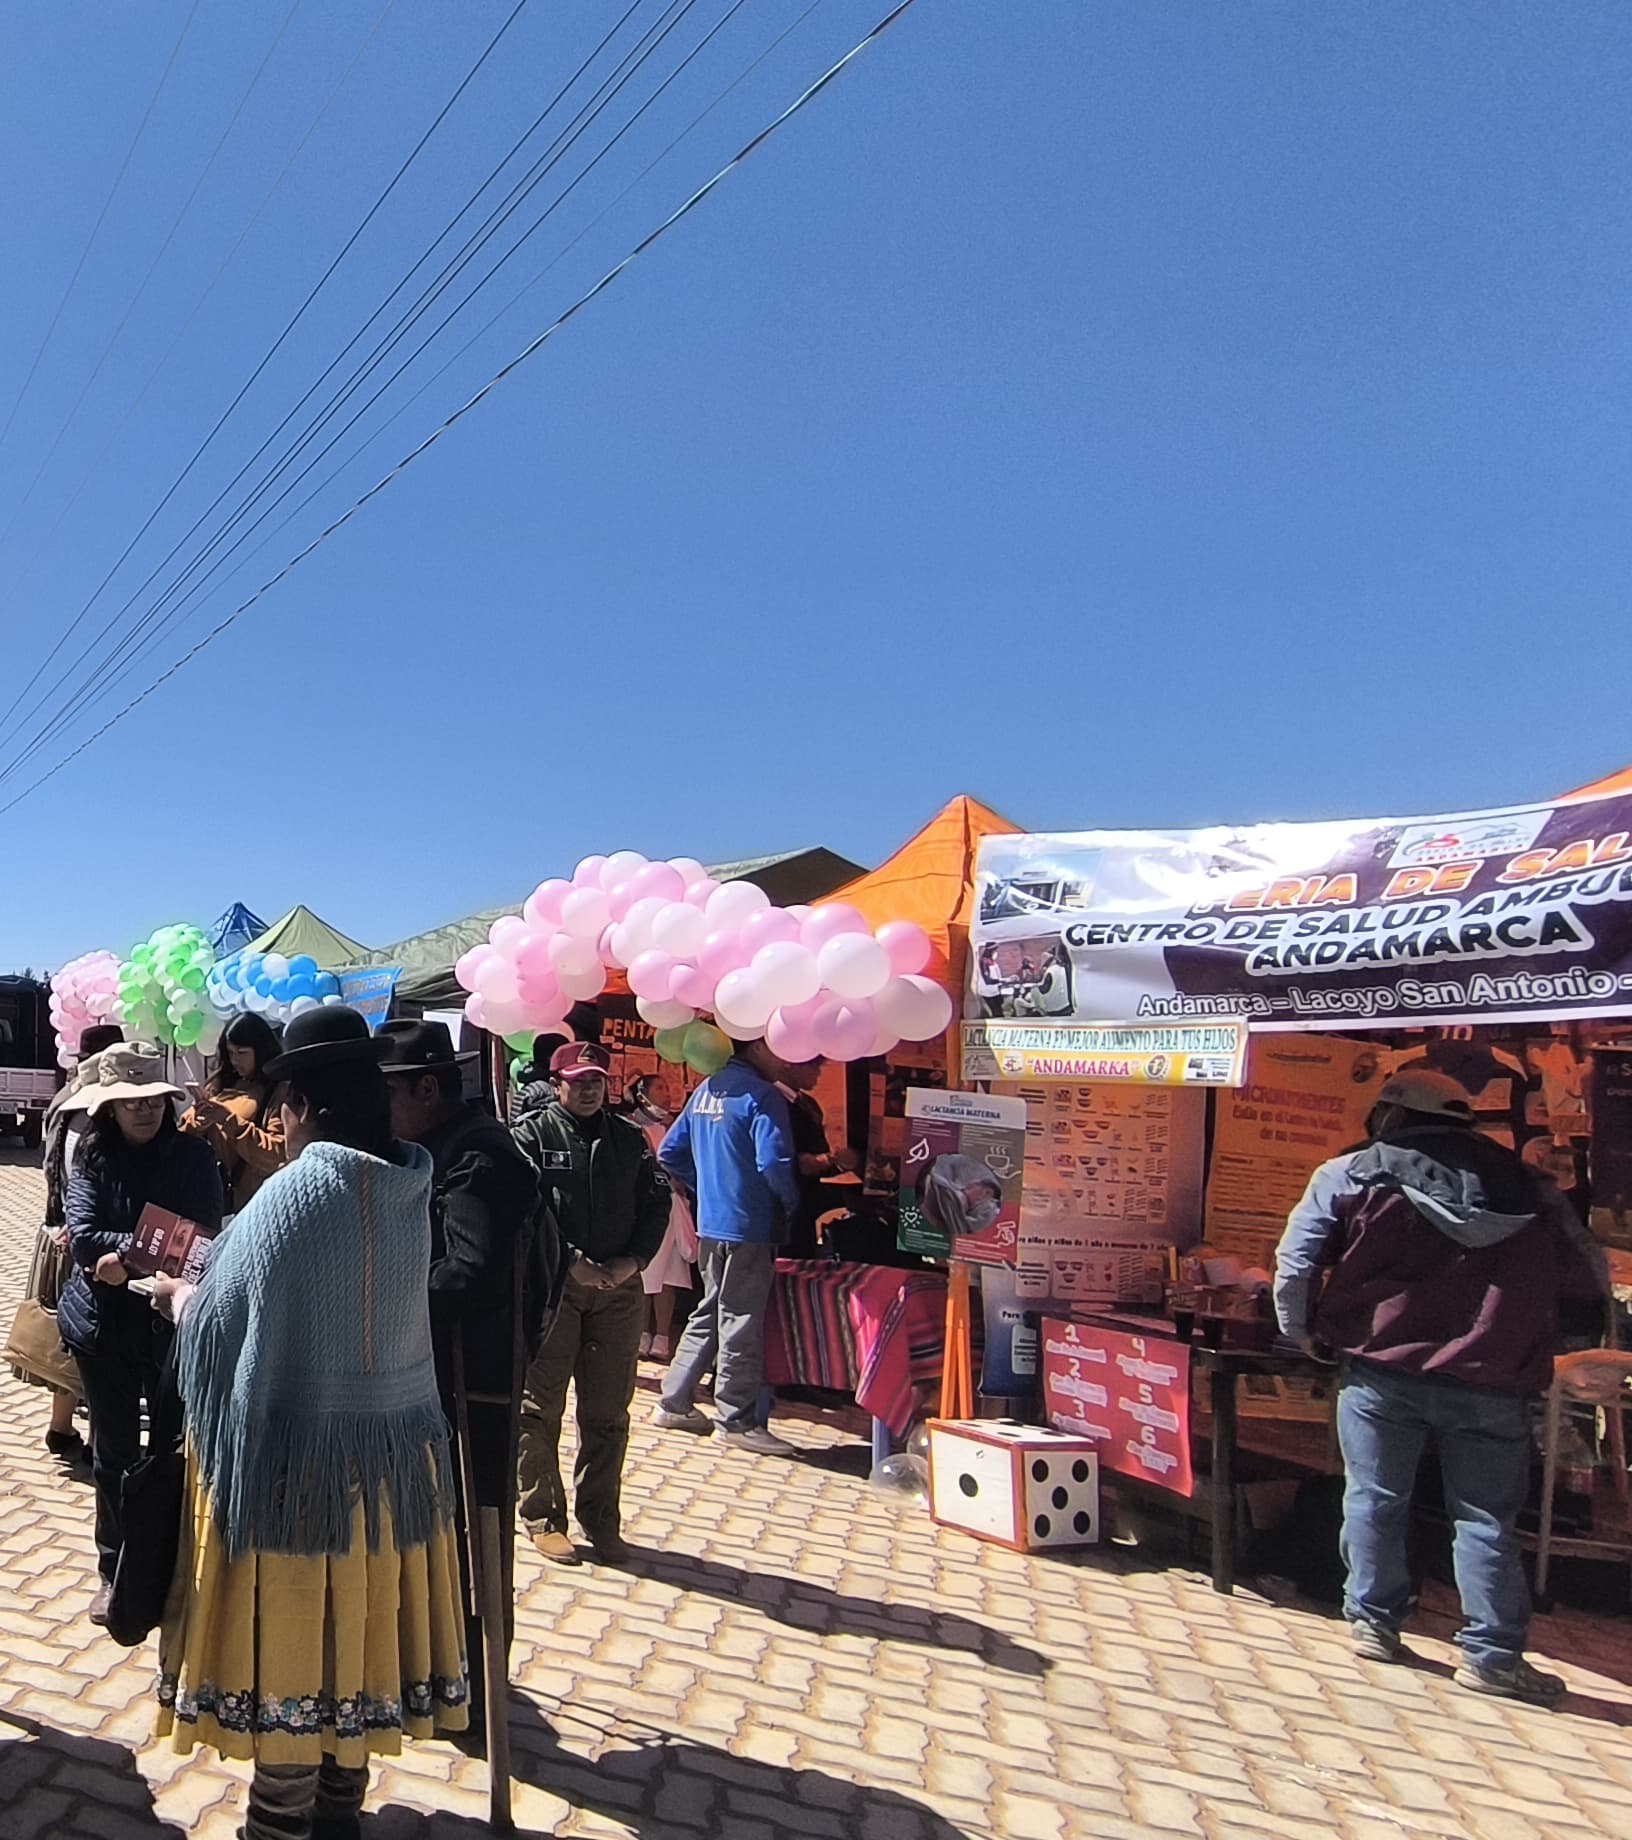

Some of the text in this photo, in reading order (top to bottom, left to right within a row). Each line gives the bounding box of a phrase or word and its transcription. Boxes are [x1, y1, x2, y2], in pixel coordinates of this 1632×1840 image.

[1196, 873, 1356, 912] ERIA
[1382, 860, 1484, 900] DE
[1066, 922, 1217, 946] CENTRO
[1224, 919, 1286, 940] DE
[1293, 904, 1450, 938] SALUD
[1253, 911, 1581, 970] ANDAMARCA
[1138, 993, 1267, 1017] Andamarca
[1290, 985, 1396, 1014] Lacoyo
[1399, 979, 1464, 1006] San
[1470, 967, 1613, 1004] Antonio
[1153, 1029, 1179, 1050] PARA
[1182, 1029, 1202, 1050] TUS
[1202, 1028, 1235, 1050] HIJOS
[966, 1108, 1001, 1119] MATERNA
[1065, 1324, 1080, 1343] 1
[1132, 1337, 1145, 1357] 4
[1068, 1357, 1081, 1378] 2
[1138, 1383, 1153, 1404] 5
[1072, 1399, 1085, 1418] 3
[1141, 1426, 1156, 1445] 6
